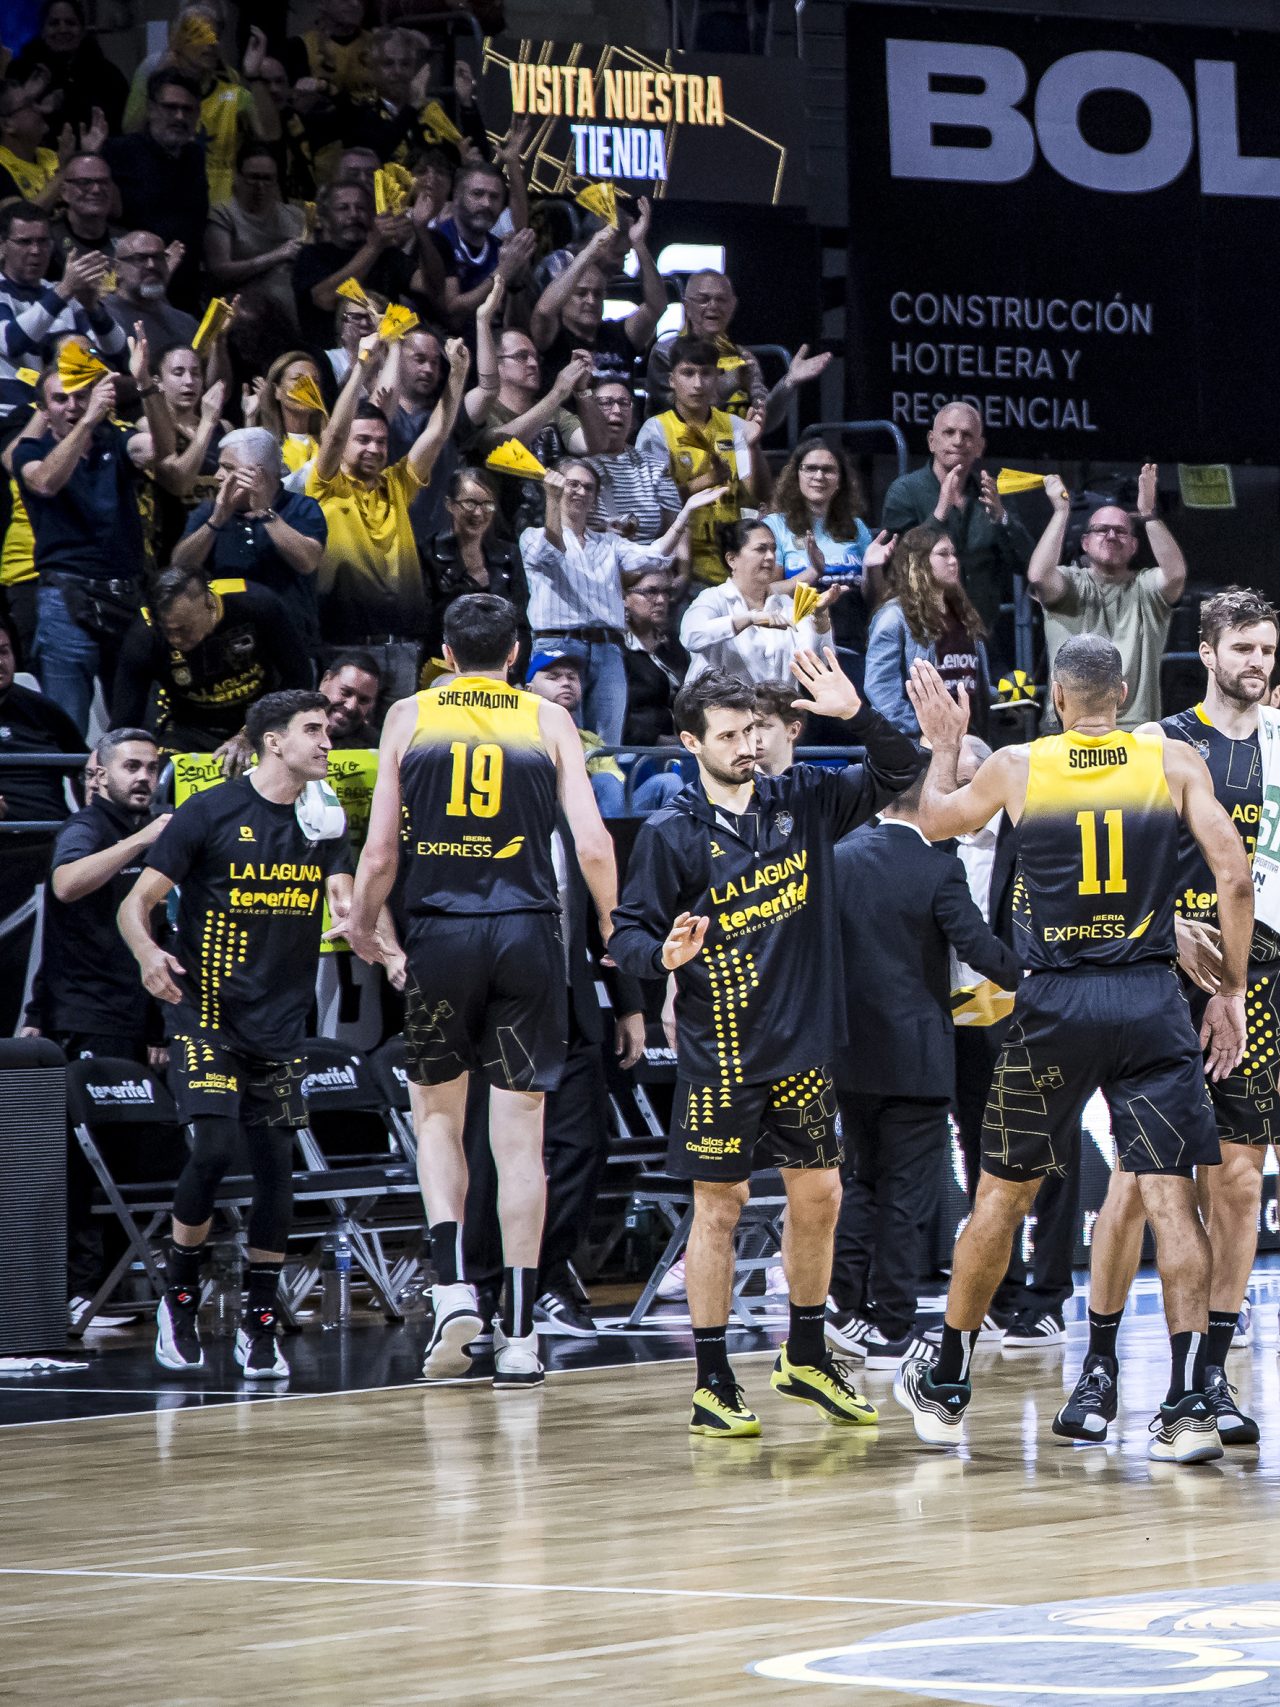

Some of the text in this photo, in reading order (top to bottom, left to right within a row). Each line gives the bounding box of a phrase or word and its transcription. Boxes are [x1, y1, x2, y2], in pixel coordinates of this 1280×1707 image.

[509, 62, 726, 127] VISITA NUESTRA
[570, 124, 668, 181] TIENDA
[890, 291, 1153, 335] CONSTRUCCIÓN
[890, 342, 1081, 381] HOTELERA Y
[892, 390, 1100, 432] RESENCIAL
[438, 691, 519, 709] SHERMADINI
[1069, 747, 1128, 768] SCRUBB
[446, 741, 504, 818] 19
[417, 842, 492, 857] EXPRESS
[1076, 809, 1127, 895] 11
[229, 863, 322, 882] LA LAGUNA
[710, 850, 807, 905] LA LAGUN
[1185, 910, 1217, 918] awake
[1044, 924, 1126, 942] EXPRESS
[686, 1142, 723, 1154] Canarias
[702, 1136, 723, 1147] Islas
